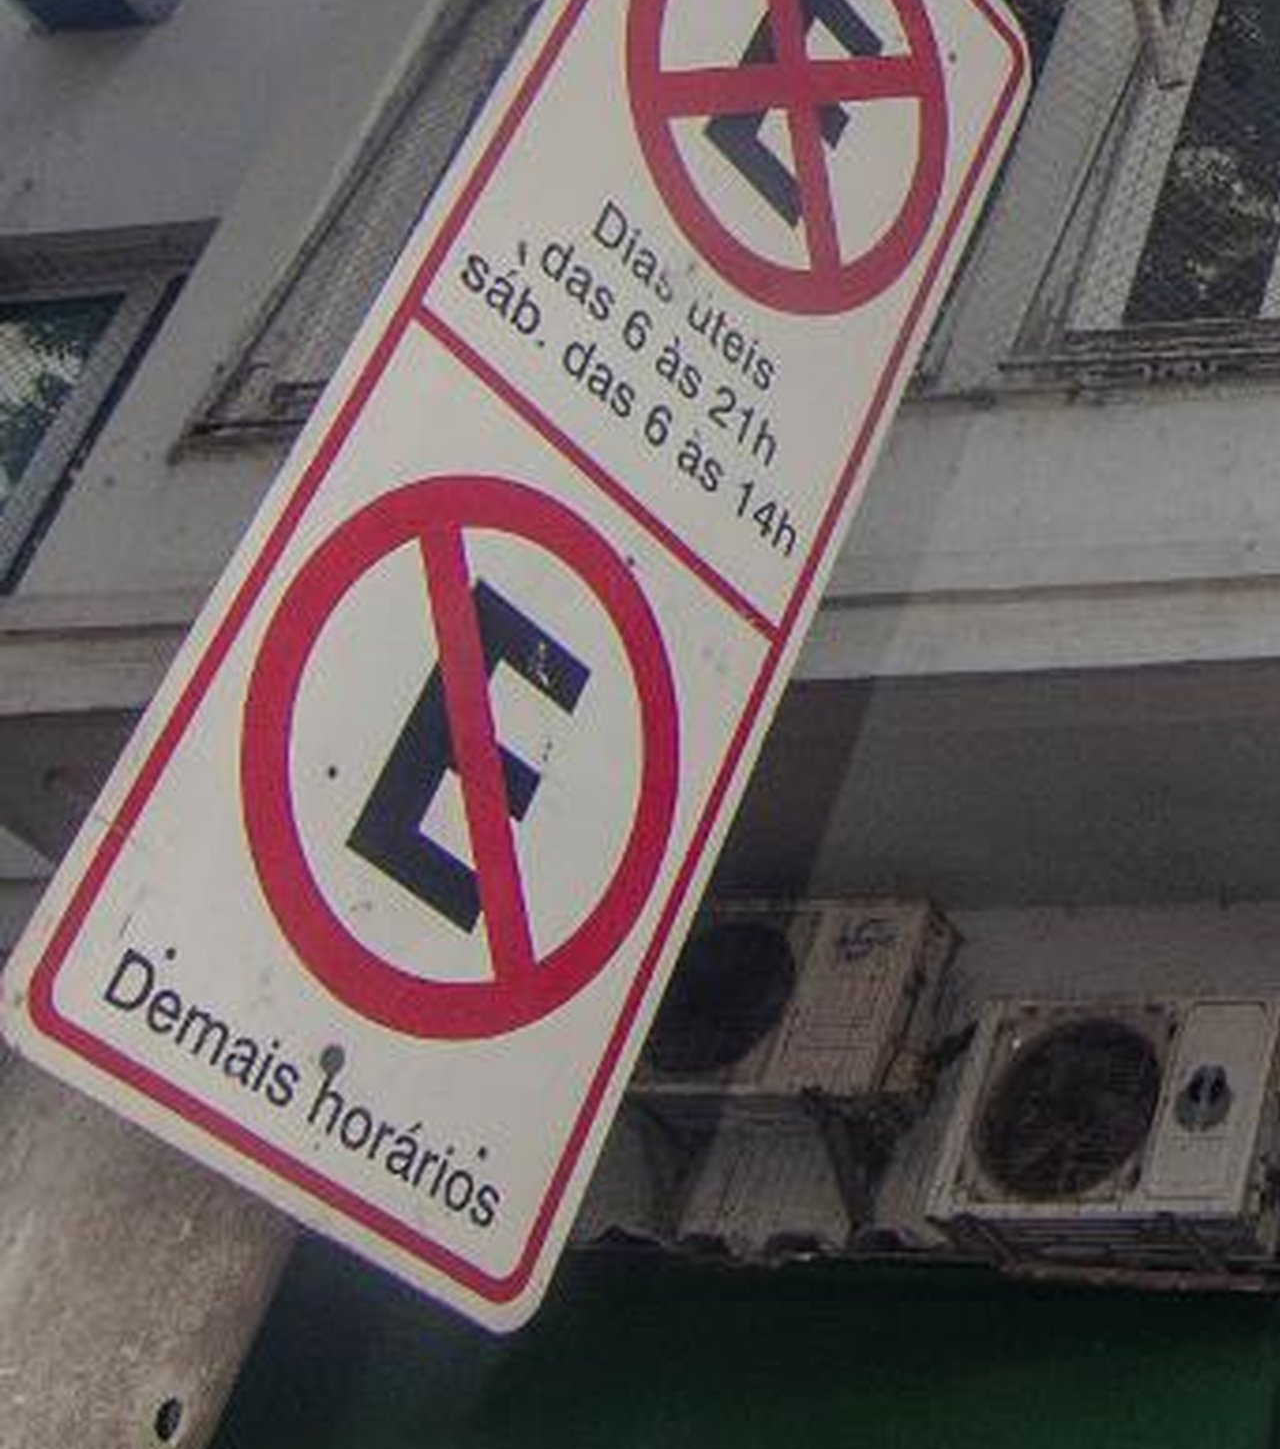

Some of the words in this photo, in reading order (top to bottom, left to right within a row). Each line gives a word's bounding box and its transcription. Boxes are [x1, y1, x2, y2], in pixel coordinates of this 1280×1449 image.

[541, 241, 616, 323] das
[621, 309, 654, 352] 6
[655, 337, 703, 400] às
[708, 386, 778, 466] 21h
[592, 200, 674, 301] Dias
[460, 253, 545, 348] sáb.
[562, 340, 637, 420] das
[643, 404, 674, 448] 6
[676, 431, 725, 493] às
[737, 481, 799, 557] 14h
[103, 947, 300, 1108] Demais
[307, 1056, 500, 1228] horários
